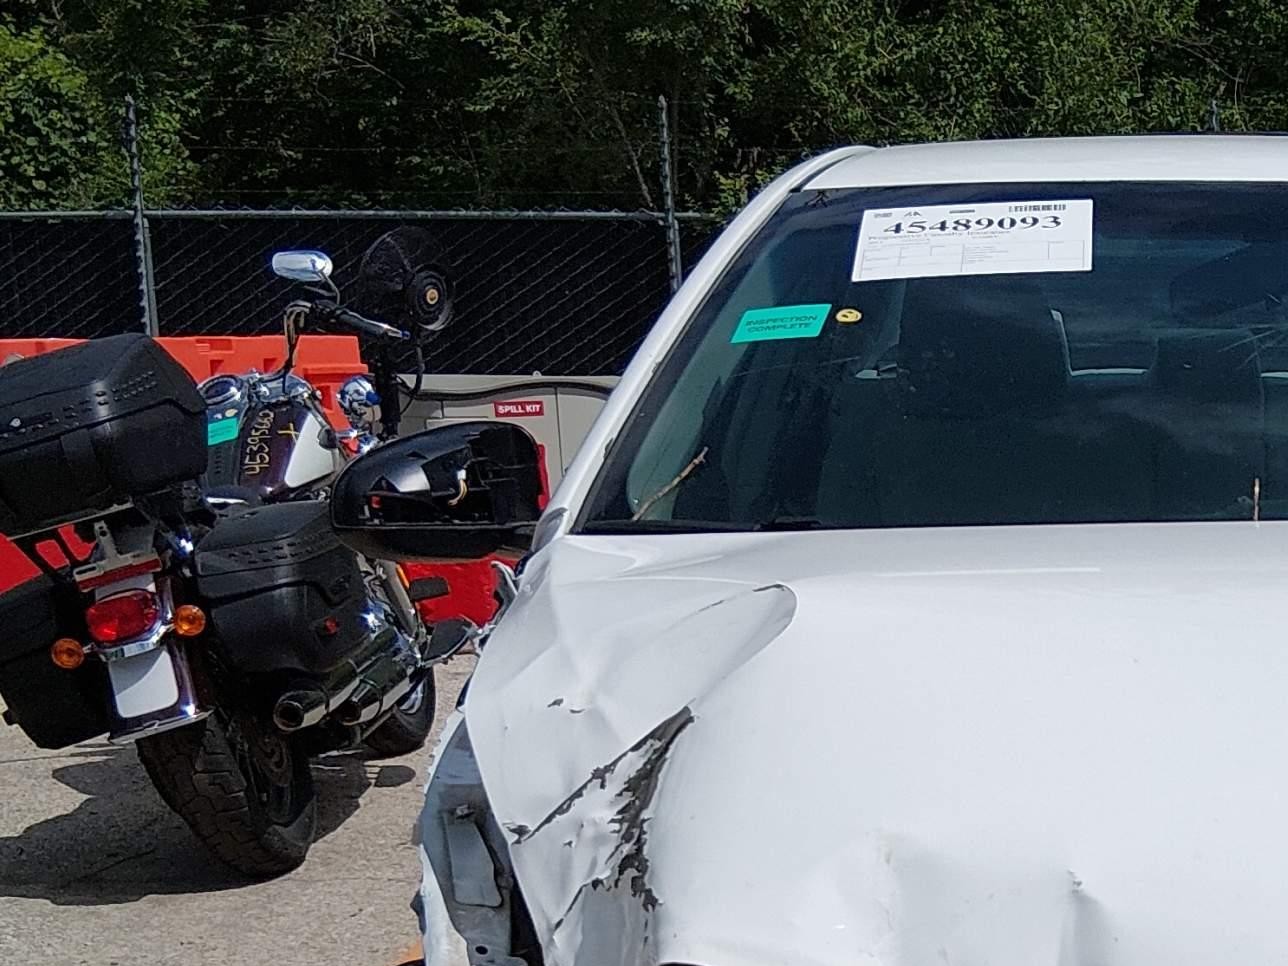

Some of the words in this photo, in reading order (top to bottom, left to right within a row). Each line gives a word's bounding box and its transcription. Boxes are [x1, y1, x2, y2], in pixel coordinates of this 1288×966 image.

[883, 215, 1062, 234] 45489093
[745, 315, 818, 326] INSPECTION
[747, 322, 812, 333] COMPLETE
[497, 404, 525, 413] SPILL
[526, 404, 541, 413] KIT
